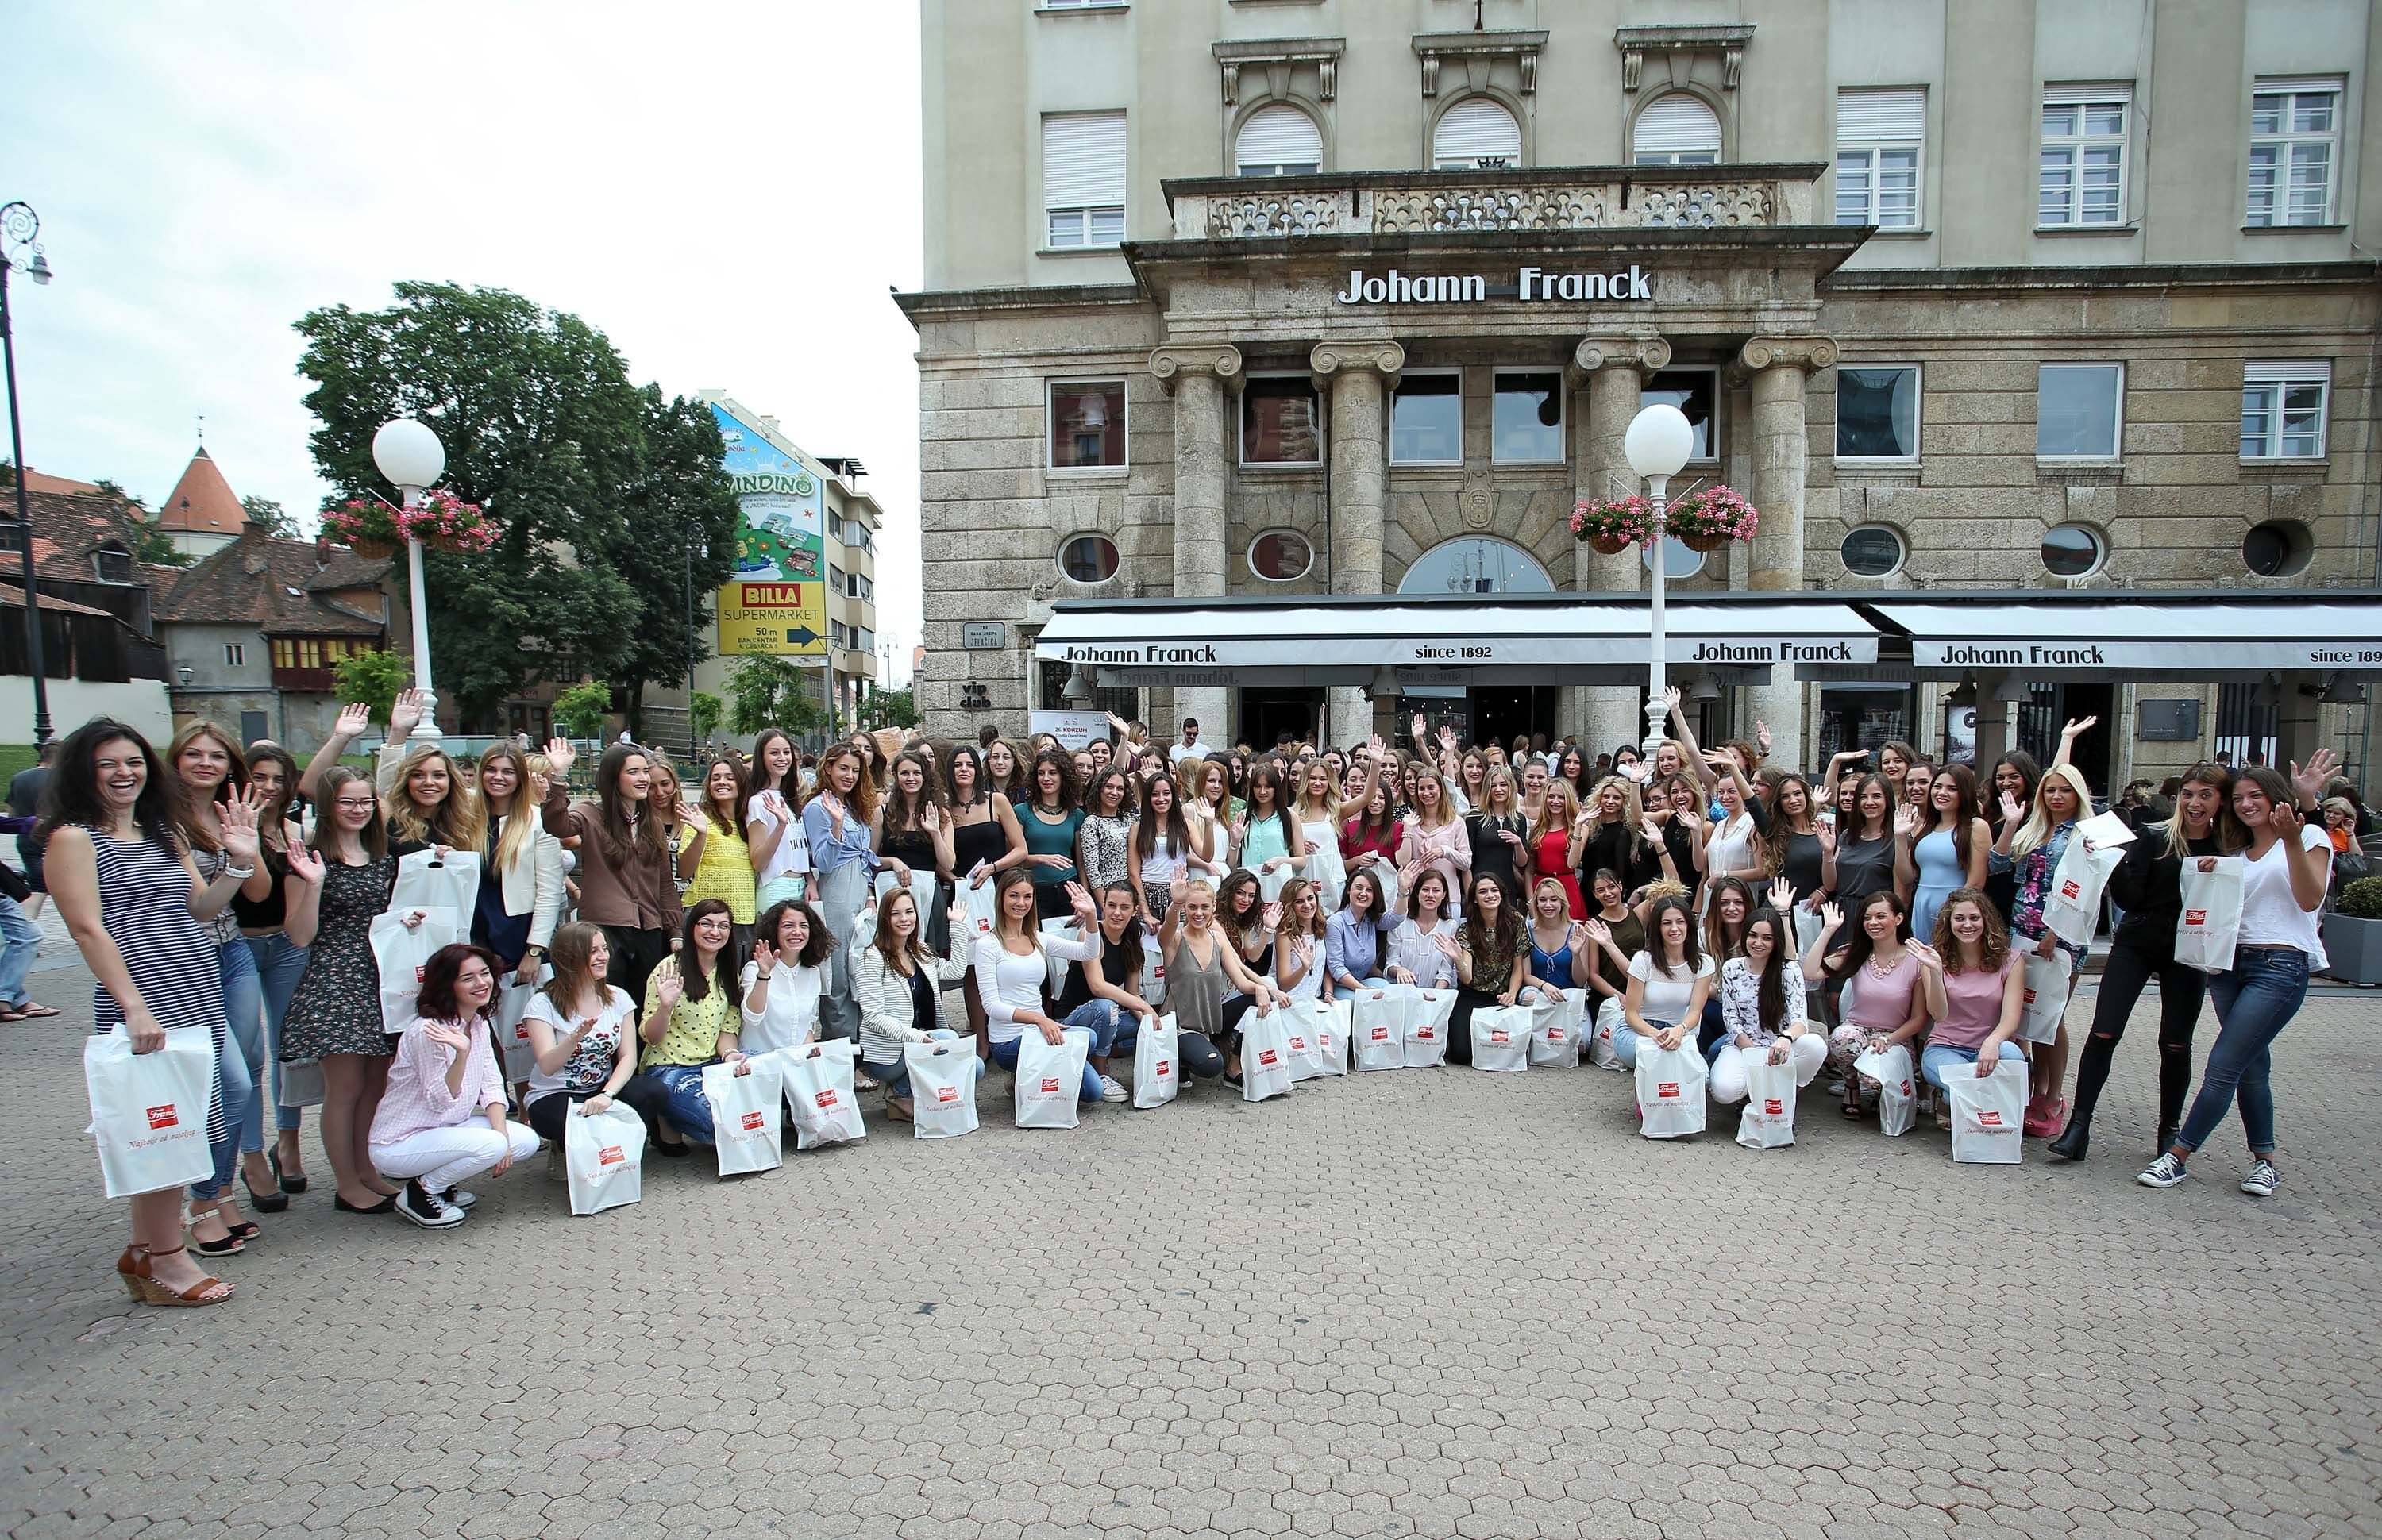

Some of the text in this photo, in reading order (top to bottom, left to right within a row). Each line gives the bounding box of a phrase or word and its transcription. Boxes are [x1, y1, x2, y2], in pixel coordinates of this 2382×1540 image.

[1337, 264, 1652, 304] Johann Franck
[746, 588, 798, 604] BILLA
[724, 609, 819, 620] SUPERMARKET
[1061, 645, 1216, 663] Johann Franck
[1415, 645, 1492, 658] since 1892
[1692, 641, 1852, 660] Johann Franck
[1941, 645, 2104, 664] Johann Franck
[2311, 649, 2353, 662] since
[962, 681, 987, 696] vip
[960, 696, 991, 707] club
